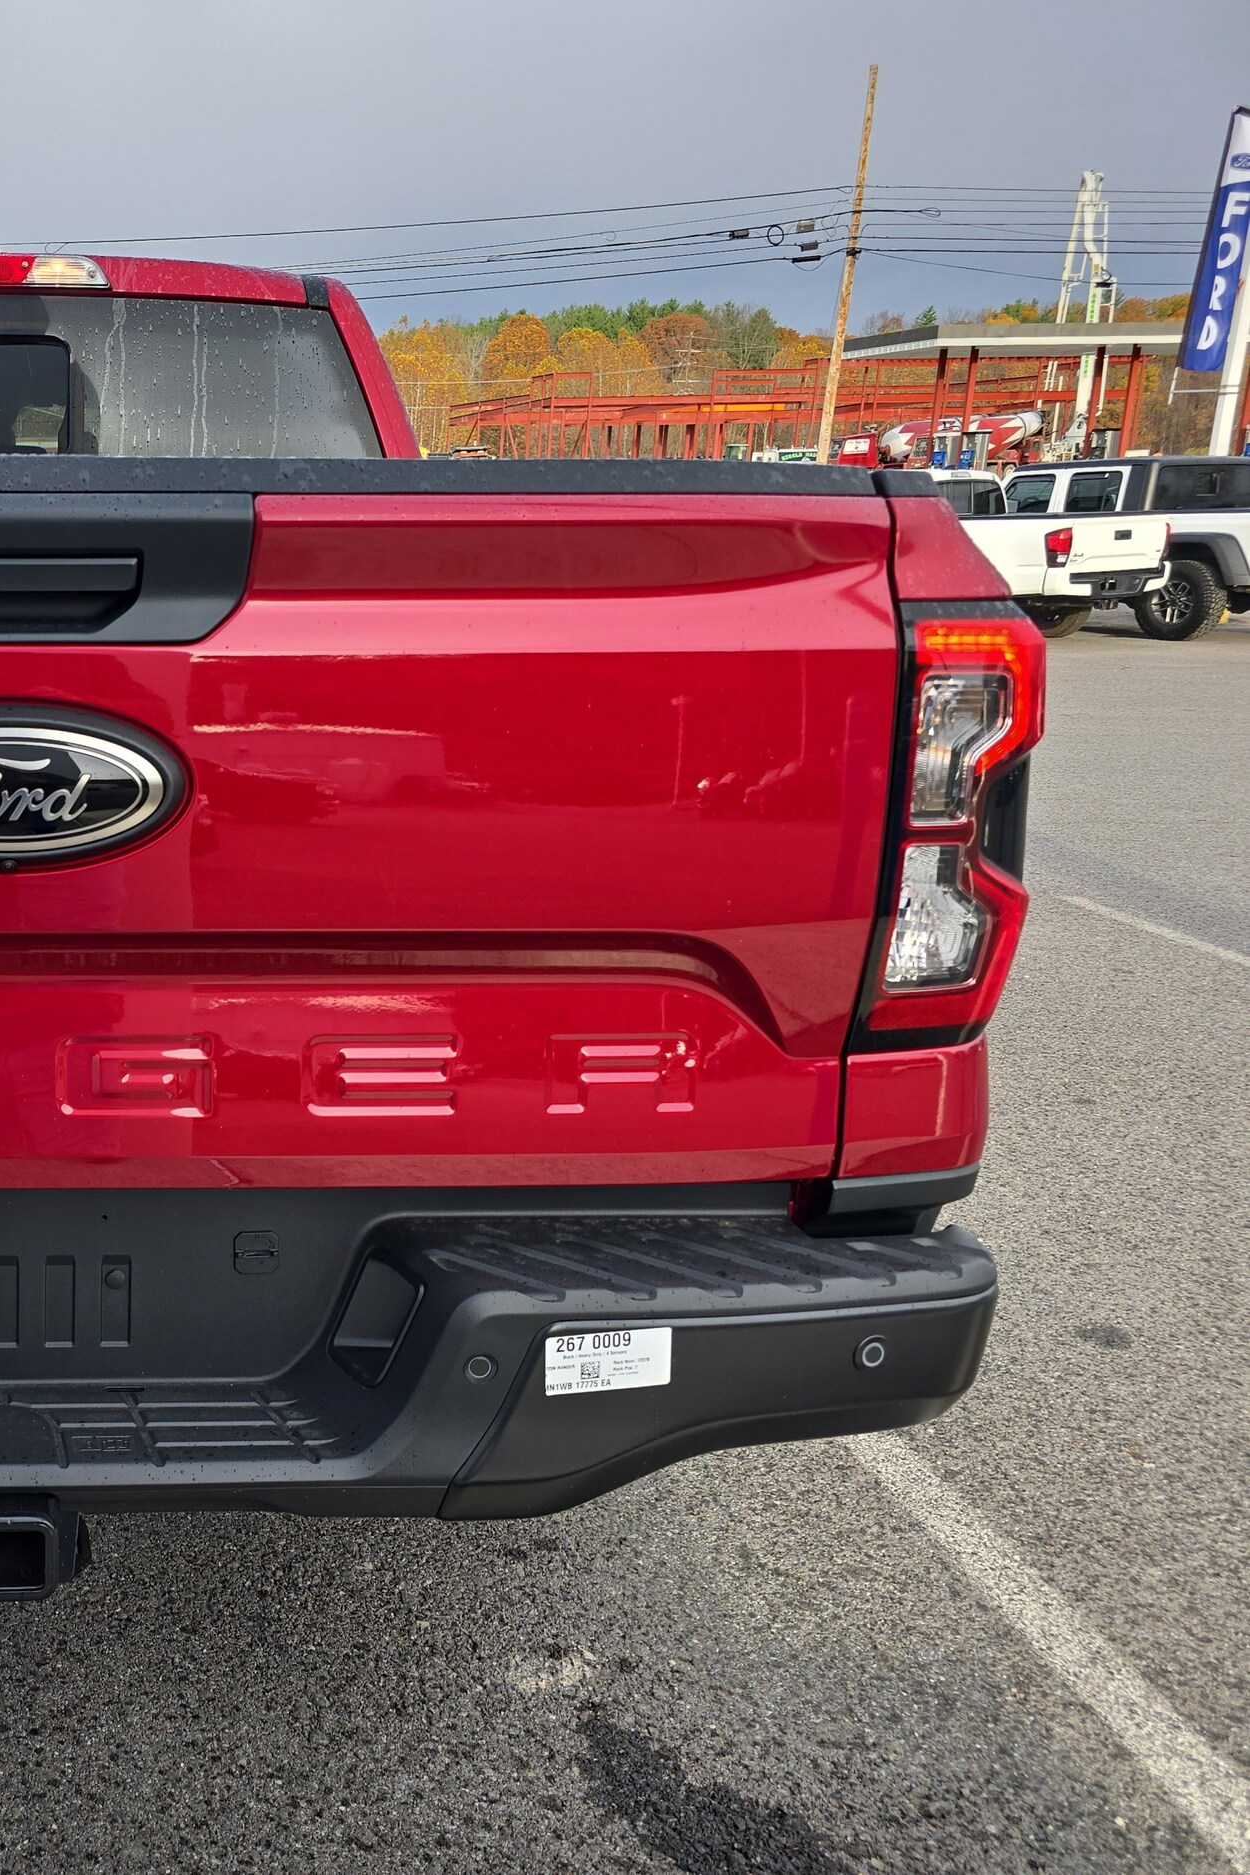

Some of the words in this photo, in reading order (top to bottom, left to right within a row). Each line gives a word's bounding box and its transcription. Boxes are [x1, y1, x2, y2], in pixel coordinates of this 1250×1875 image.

[1233, 155, 1250, 168] Fo
[1196, 192, 1250, 351] FORD
[556, 1336, 585, 1353] 267
[592, 1331, 632, 1350] 0009
[575, 1379, 598, 1389] 17775
[600, 1378, 611, 1387] EA
